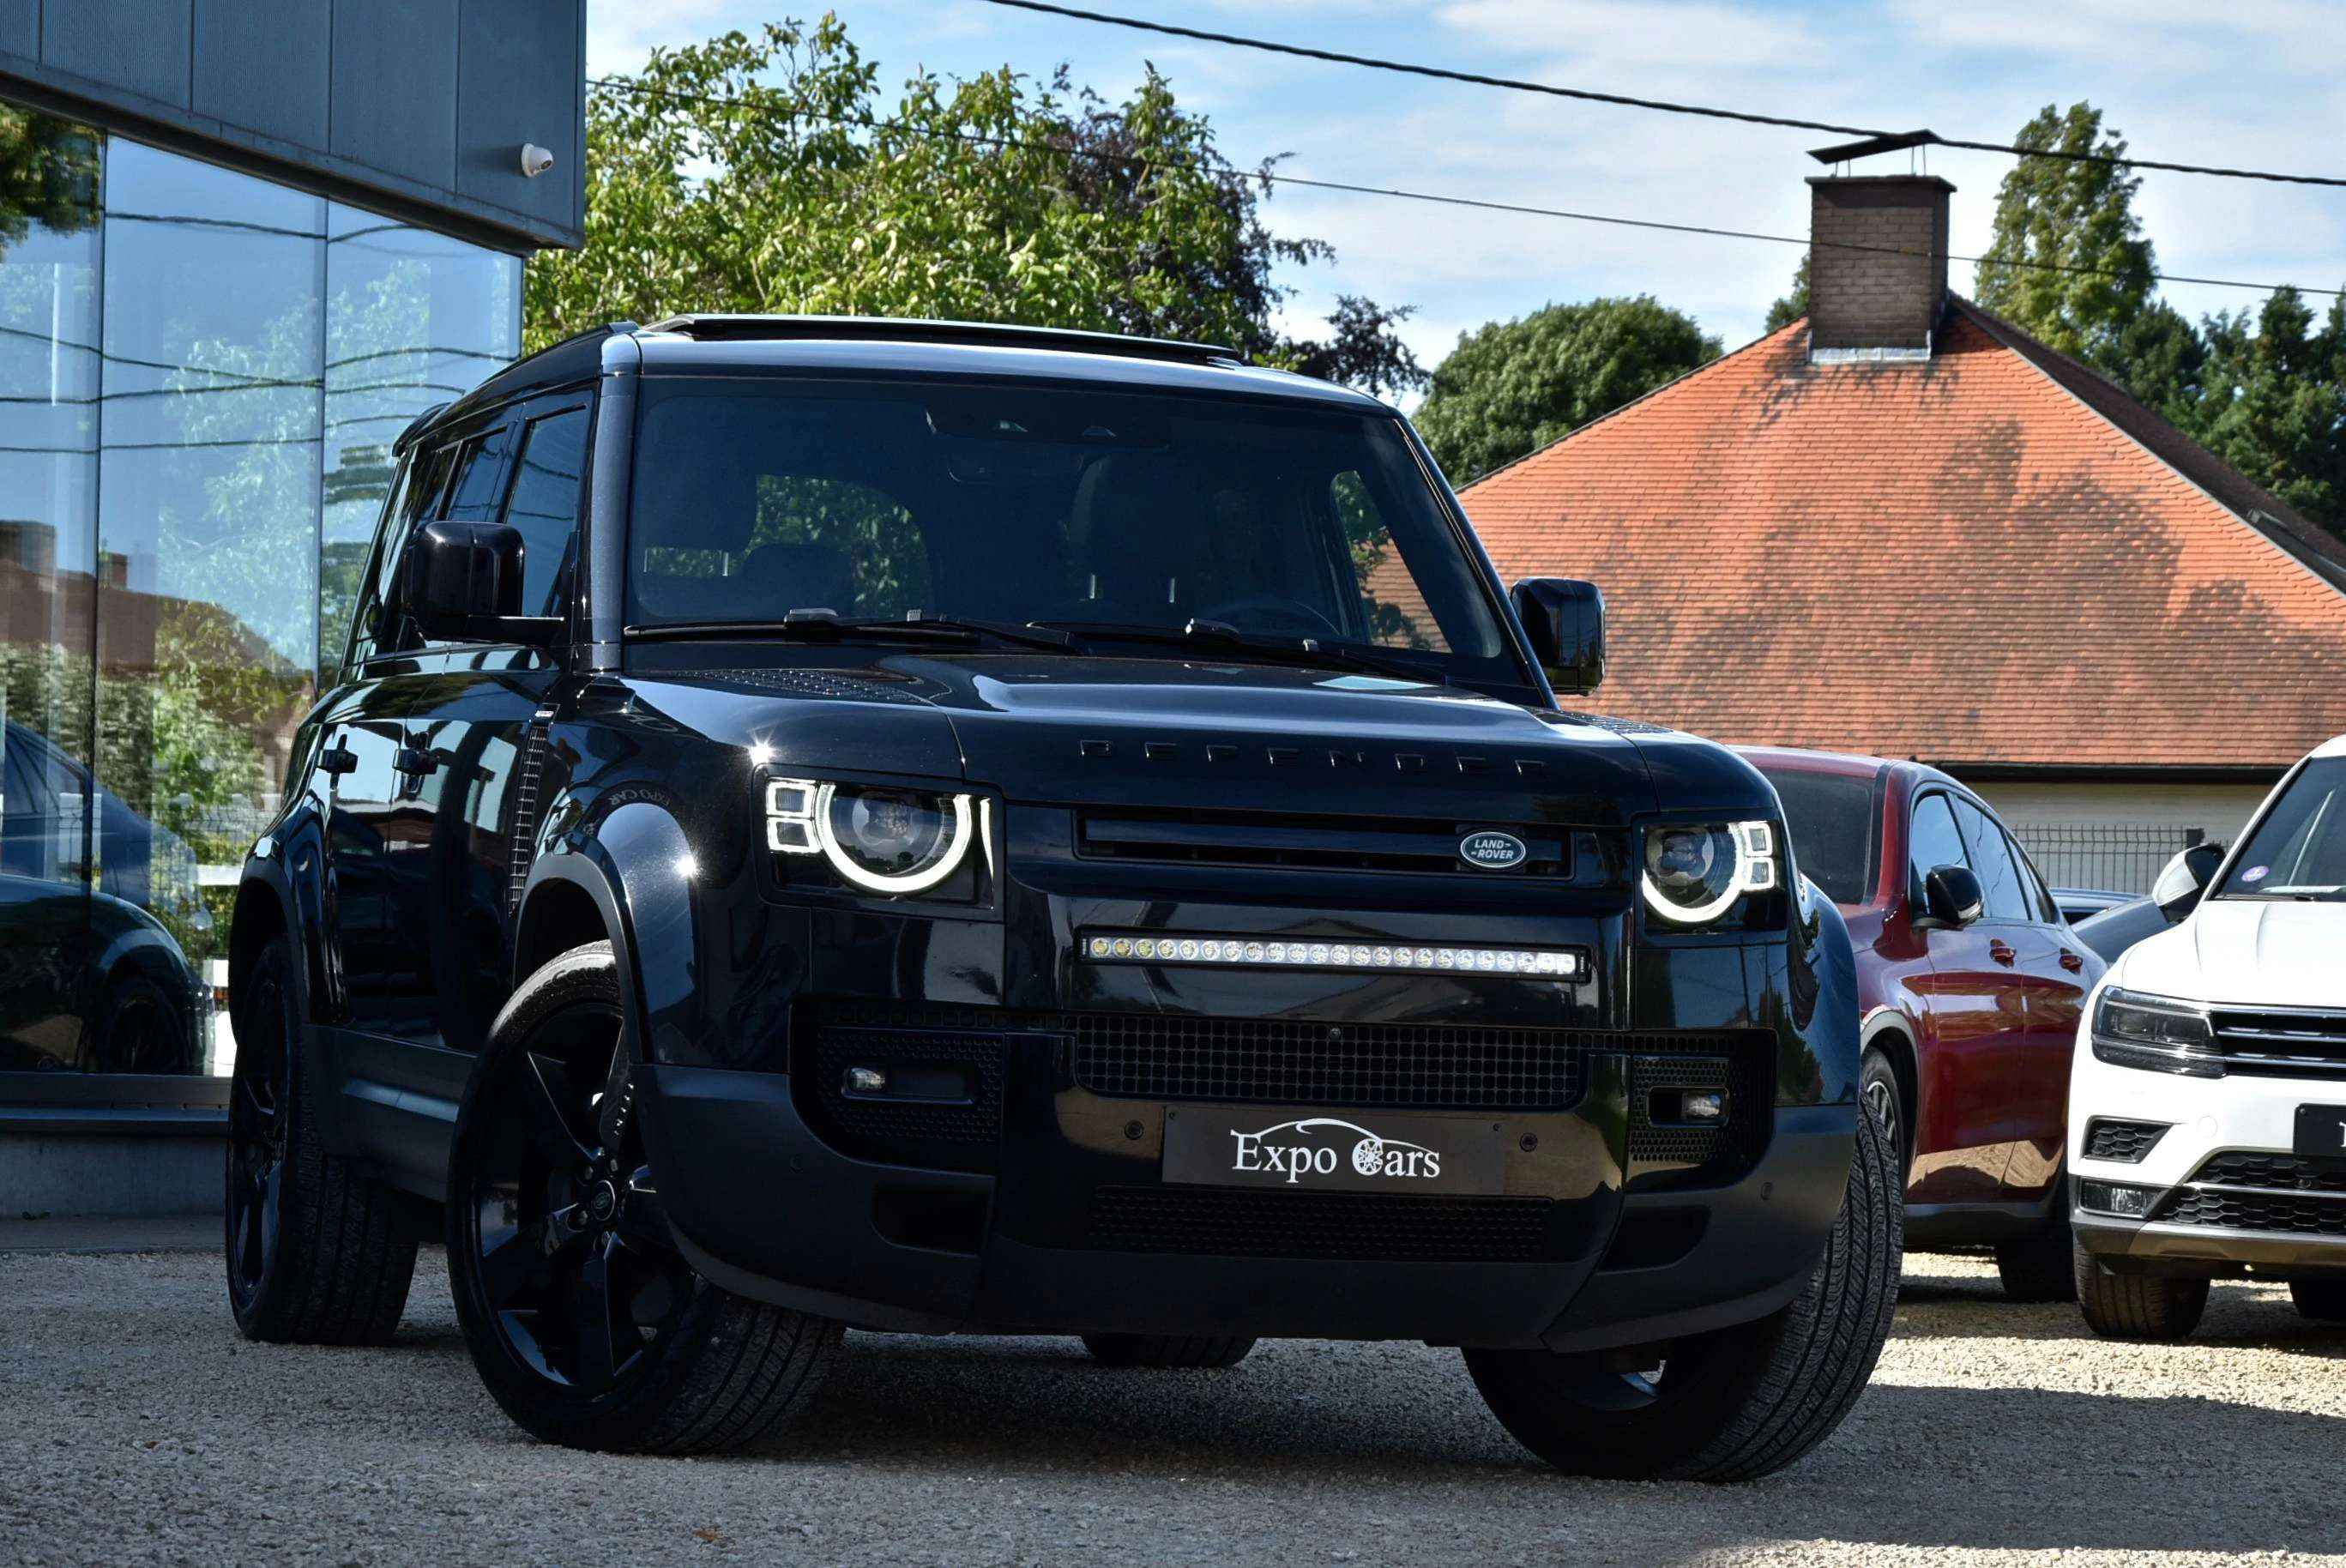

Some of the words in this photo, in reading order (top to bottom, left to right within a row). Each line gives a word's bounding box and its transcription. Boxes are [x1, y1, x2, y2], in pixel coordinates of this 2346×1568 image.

[1079, 739, 1547, 775] DEFENDER
[1230, 1128, 1337, 1184] Expo
[1351, 1137, 1441, 1179] Cars
